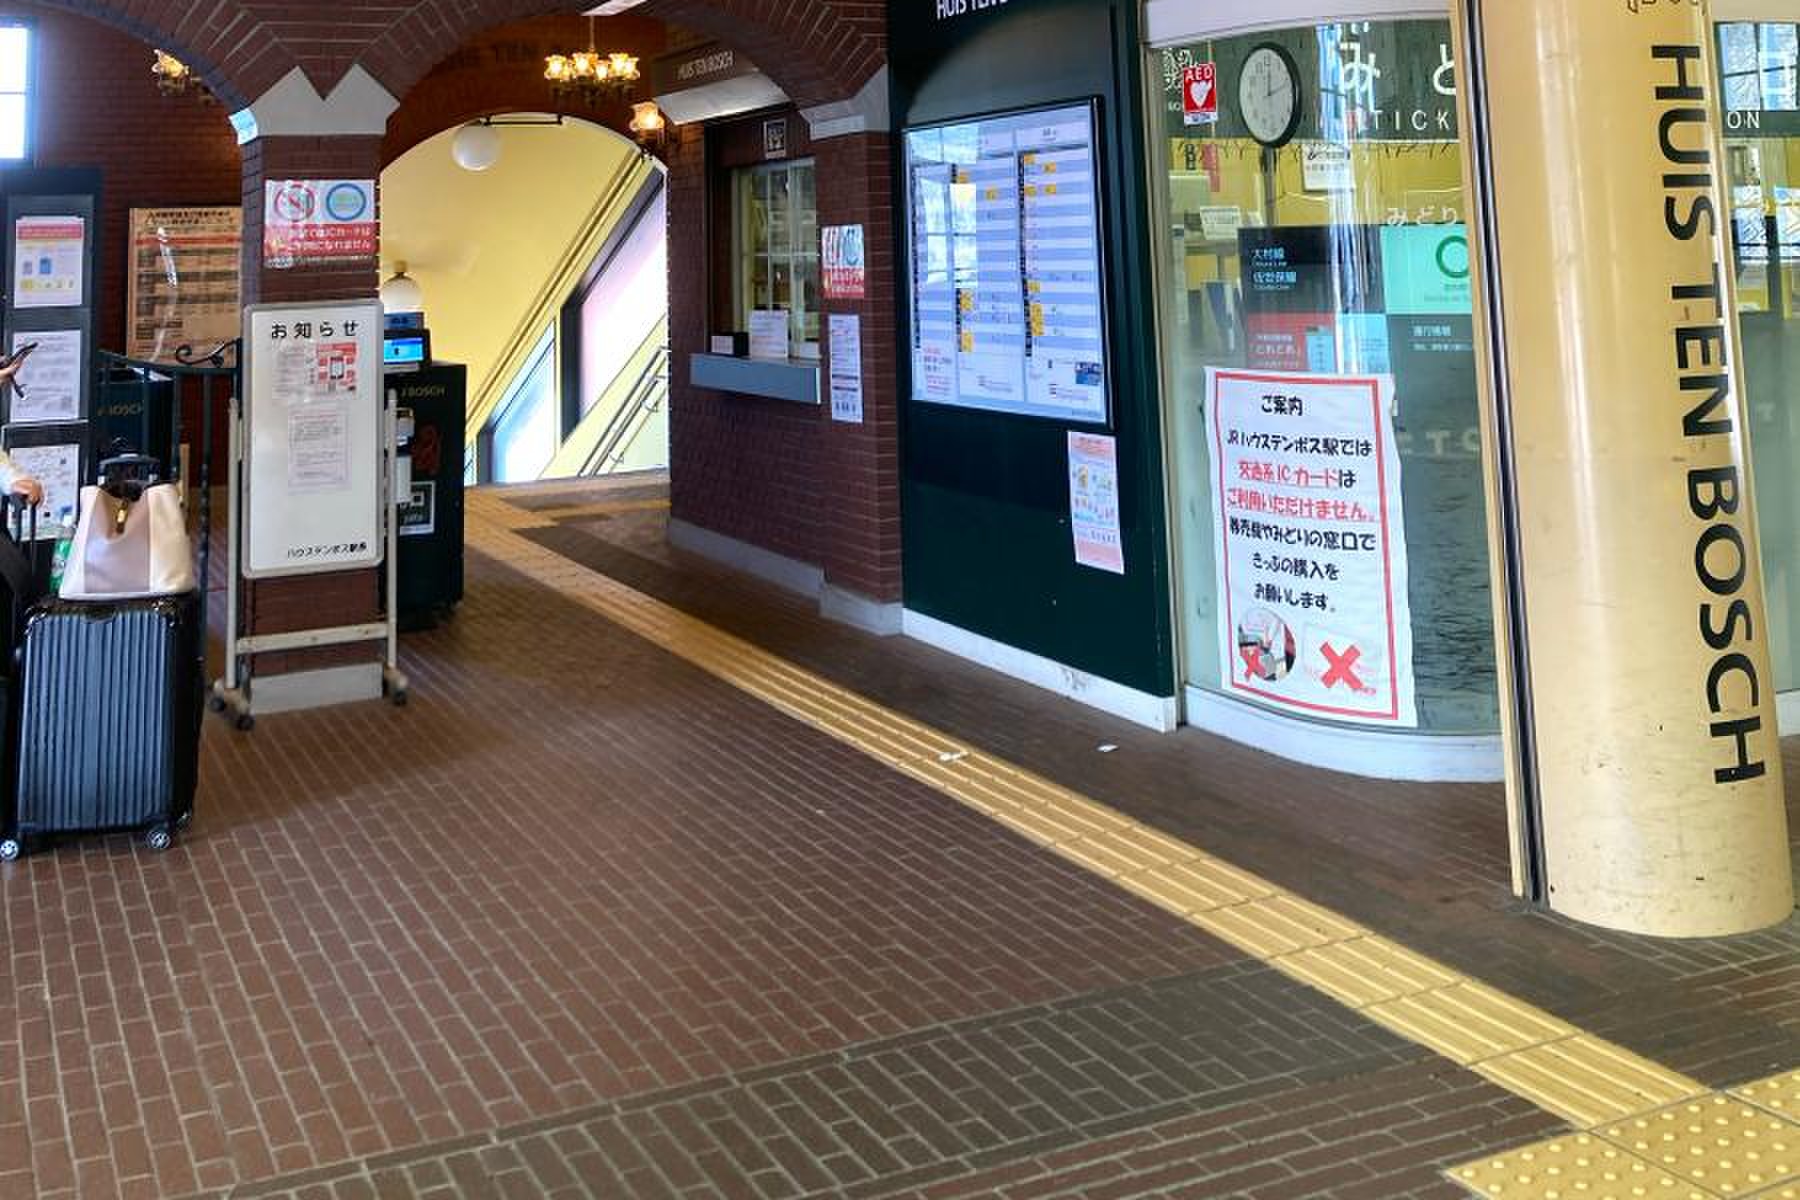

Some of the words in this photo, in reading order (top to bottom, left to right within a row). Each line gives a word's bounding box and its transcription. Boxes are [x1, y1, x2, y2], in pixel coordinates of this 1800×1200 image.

[1185, 64, 1213, 84] AED
[1651, 45, 1715, 242] HUIS
[271, 320, 360, 340] お知らせ
[1671, 262, 1732, 438] TEN
[1260, 395, 1303, 416] ご案内
[1229, 515, 1377, 551] 券売機やみどりの窓口で
[1252, 551, 1340, 581] きっぷの購入を
[1253, 582, 1337, 613] お願いします。
[1687, 466, 1767, 784] BOSCH
